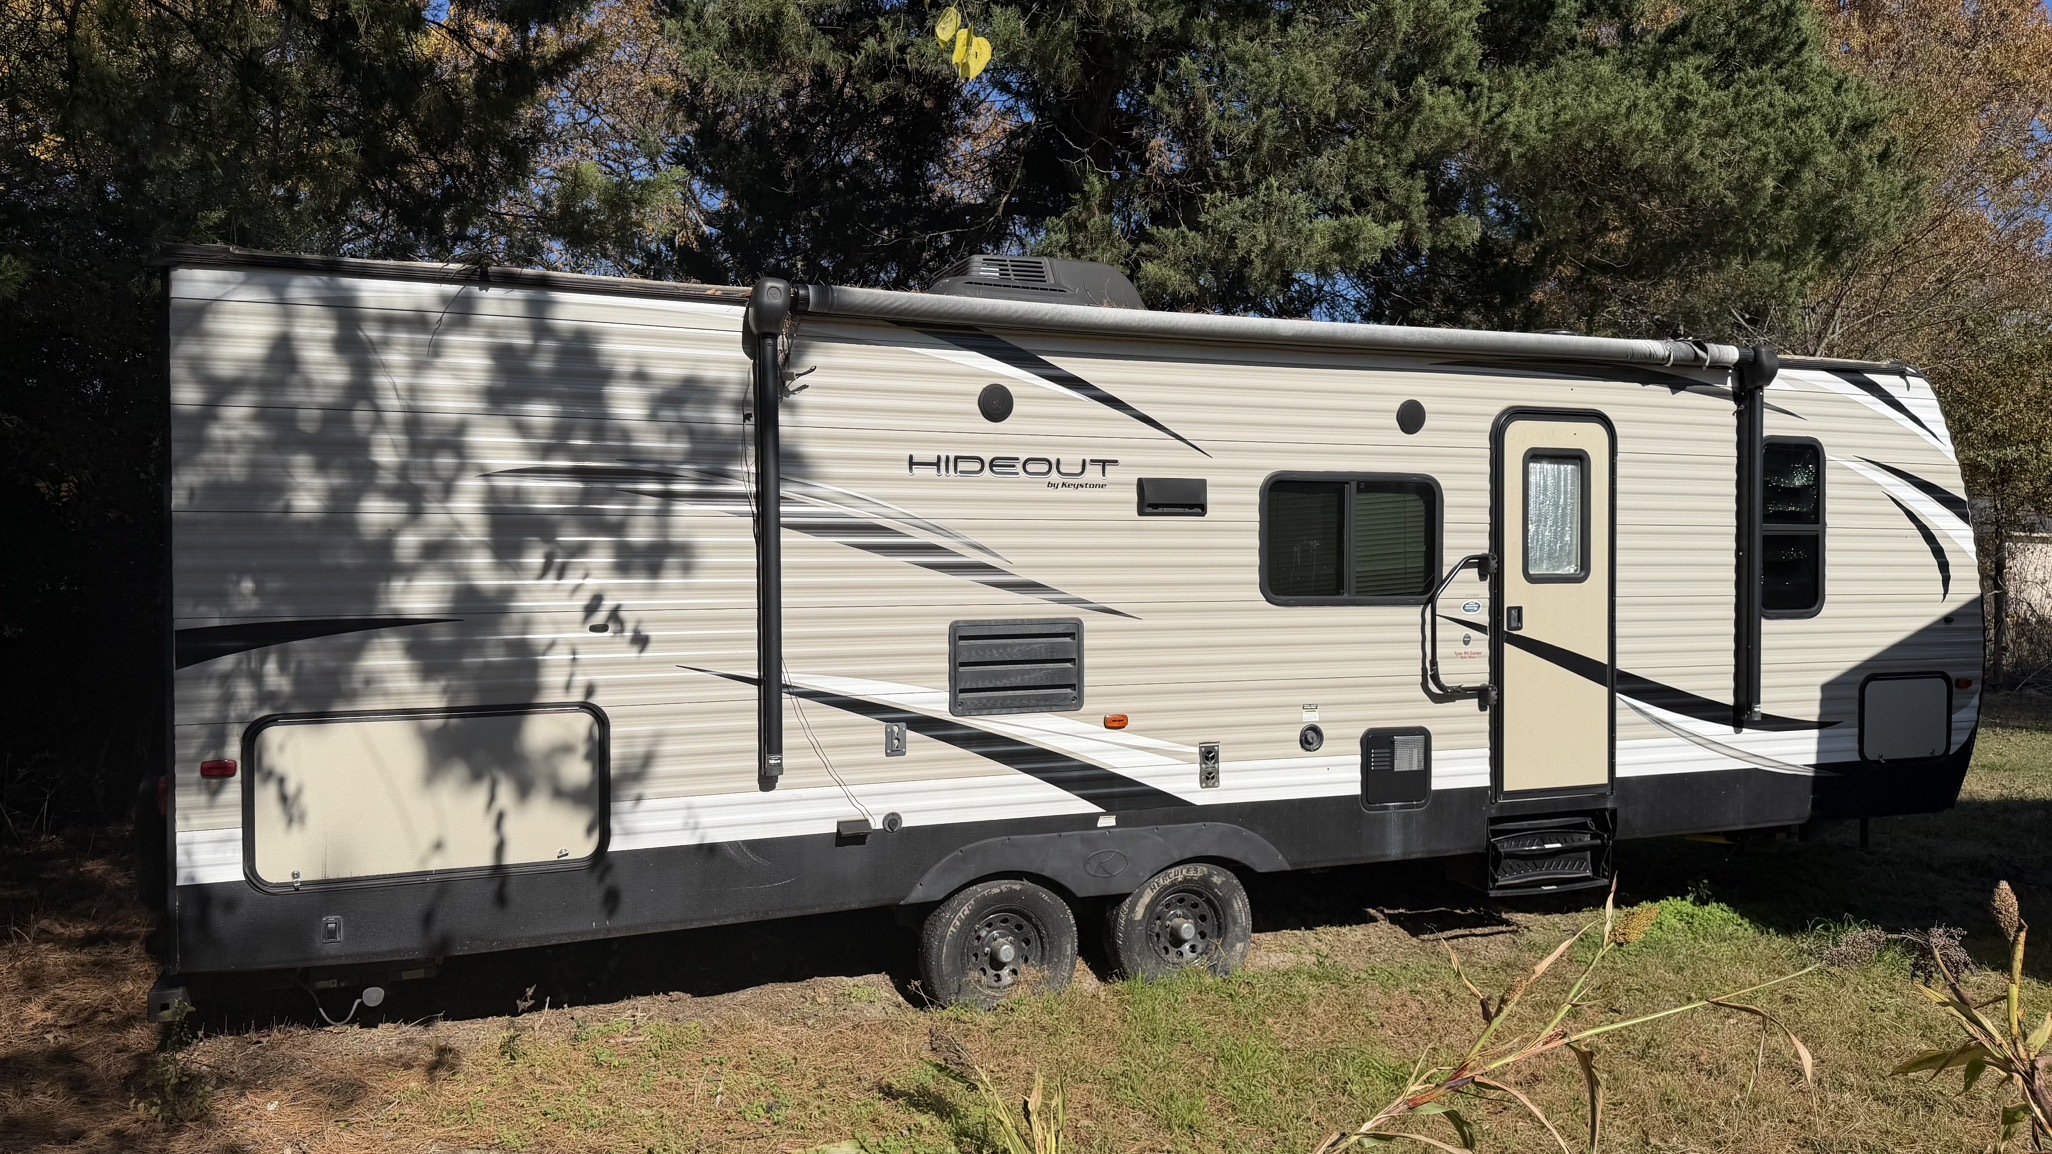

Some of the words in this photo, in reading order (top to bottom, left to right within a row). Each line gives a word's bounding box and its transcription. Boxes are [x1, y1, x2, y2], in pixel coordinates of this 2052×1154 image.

[908, 454, 1120, 478] HIDEOUT
[1047, 481, 1059, 490] by
[1061, 481, 1107, 490] Keystone
